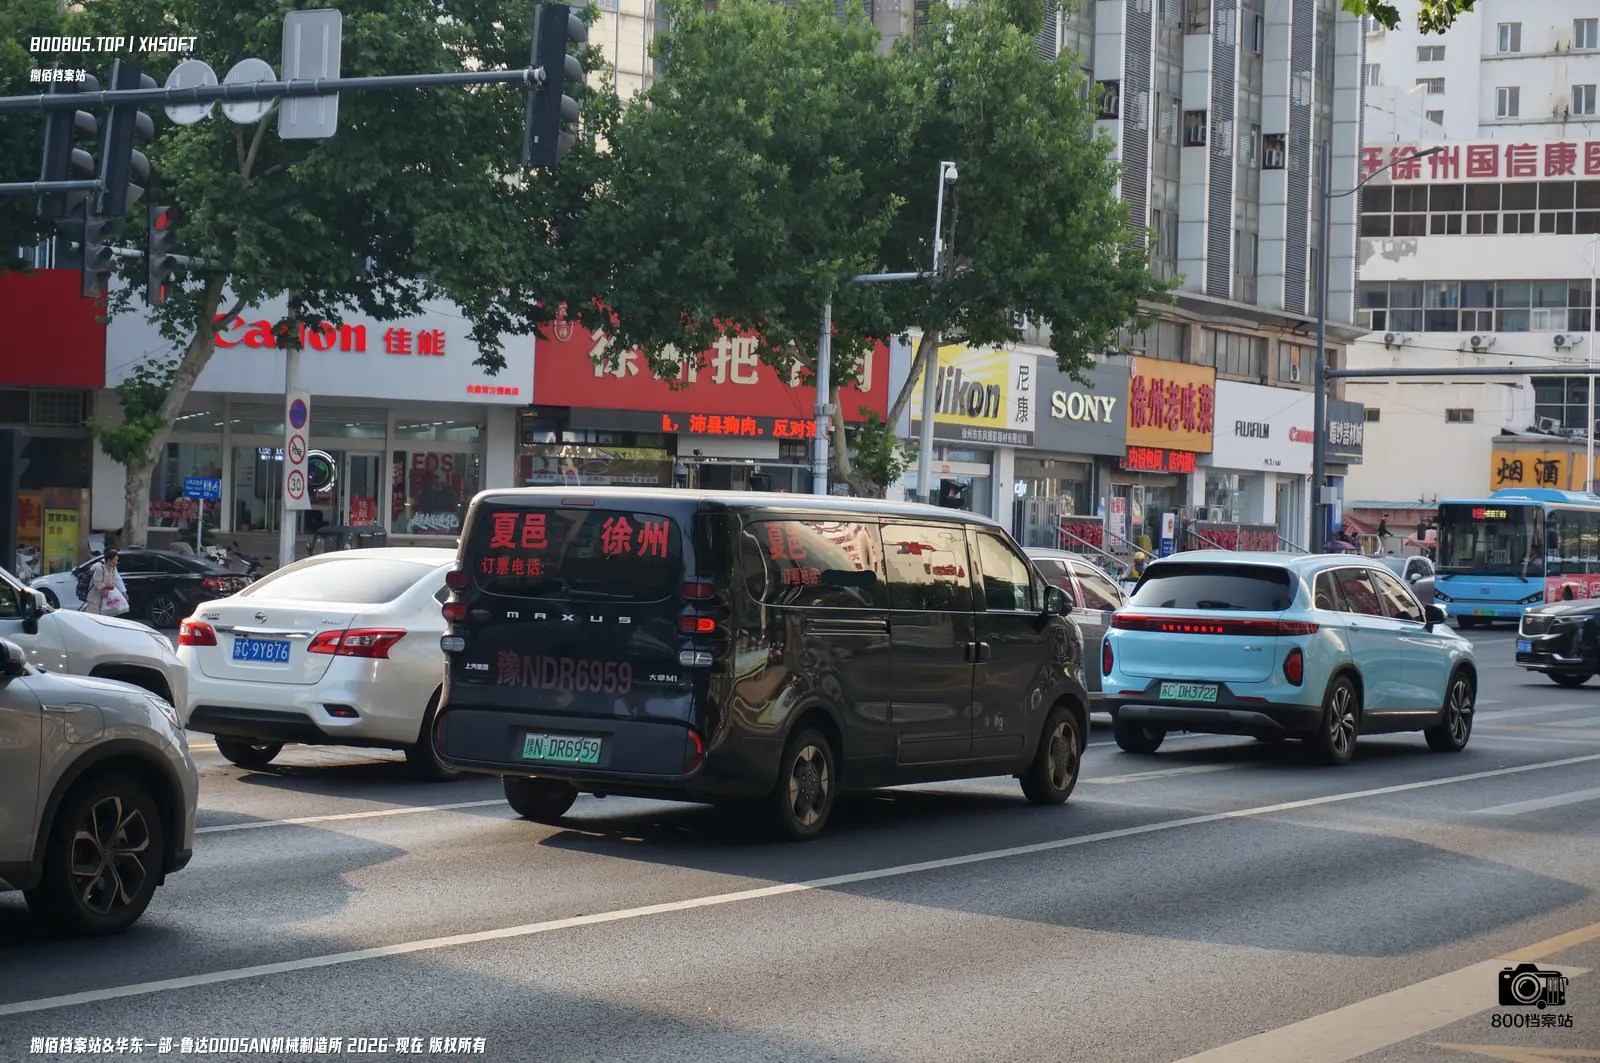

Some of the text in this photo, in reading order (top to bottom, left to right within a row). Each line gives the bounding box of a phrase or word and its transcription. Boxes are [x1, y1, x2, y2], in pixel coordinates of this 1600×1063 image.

[383, 327, 446, 356] 佳能
[1015, 365, 1030, 424] 尼康
[1051, 390, 1117, 424] SONY
[1235, 420, 1270, 439] FUJIFILM
[412, 451, 454, 473] EOS
[1496, 457, 1561, 486] 烟酒
[290, 478, 301, 491] 30
[489, 512, 671, 559] 夏邑 徐州
[764, 522, 808, 560] 夏邑
[506, 610, 632, 625] MAXUS
[1161, 624, 1224, 633] SKYWORTH
[496, 650, 633, 694] 豫NDR6959
